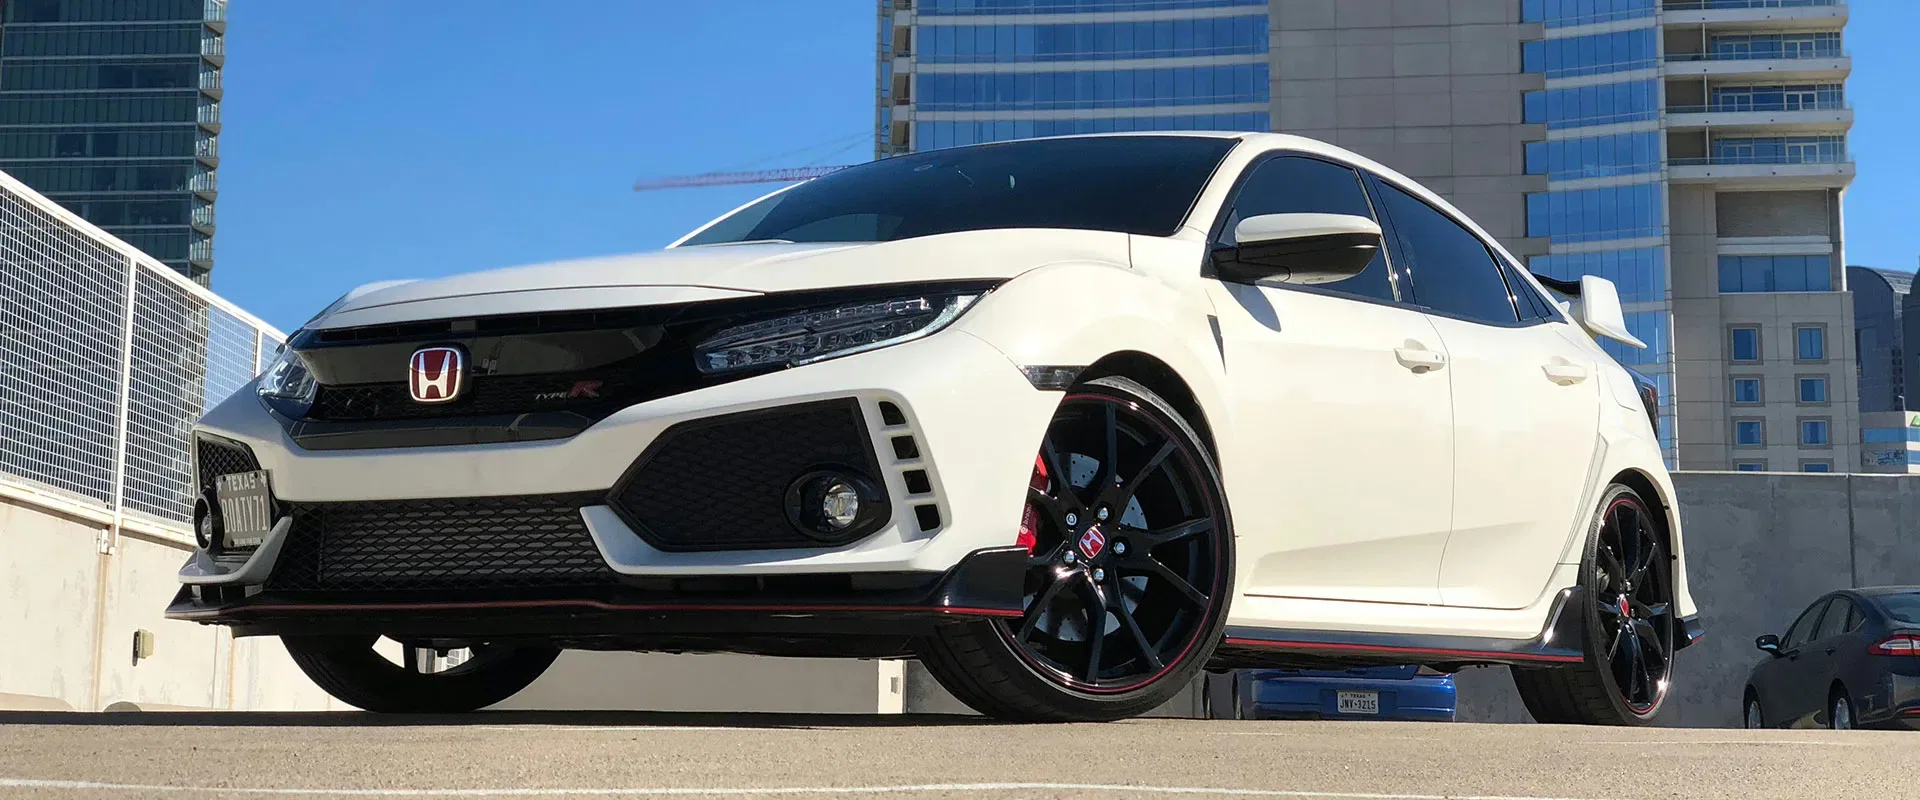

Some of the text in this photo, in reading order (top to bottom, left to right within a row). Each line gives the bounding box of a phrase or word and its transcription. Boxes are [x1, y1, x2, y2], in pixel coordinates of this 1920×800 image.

[535, 382, 602, 400] TYPE R
[226, 473, 256, 491] TEXAS
[221, 495, 267, 533] BOATY71
[1590, 521, 1600, 558] Continental
